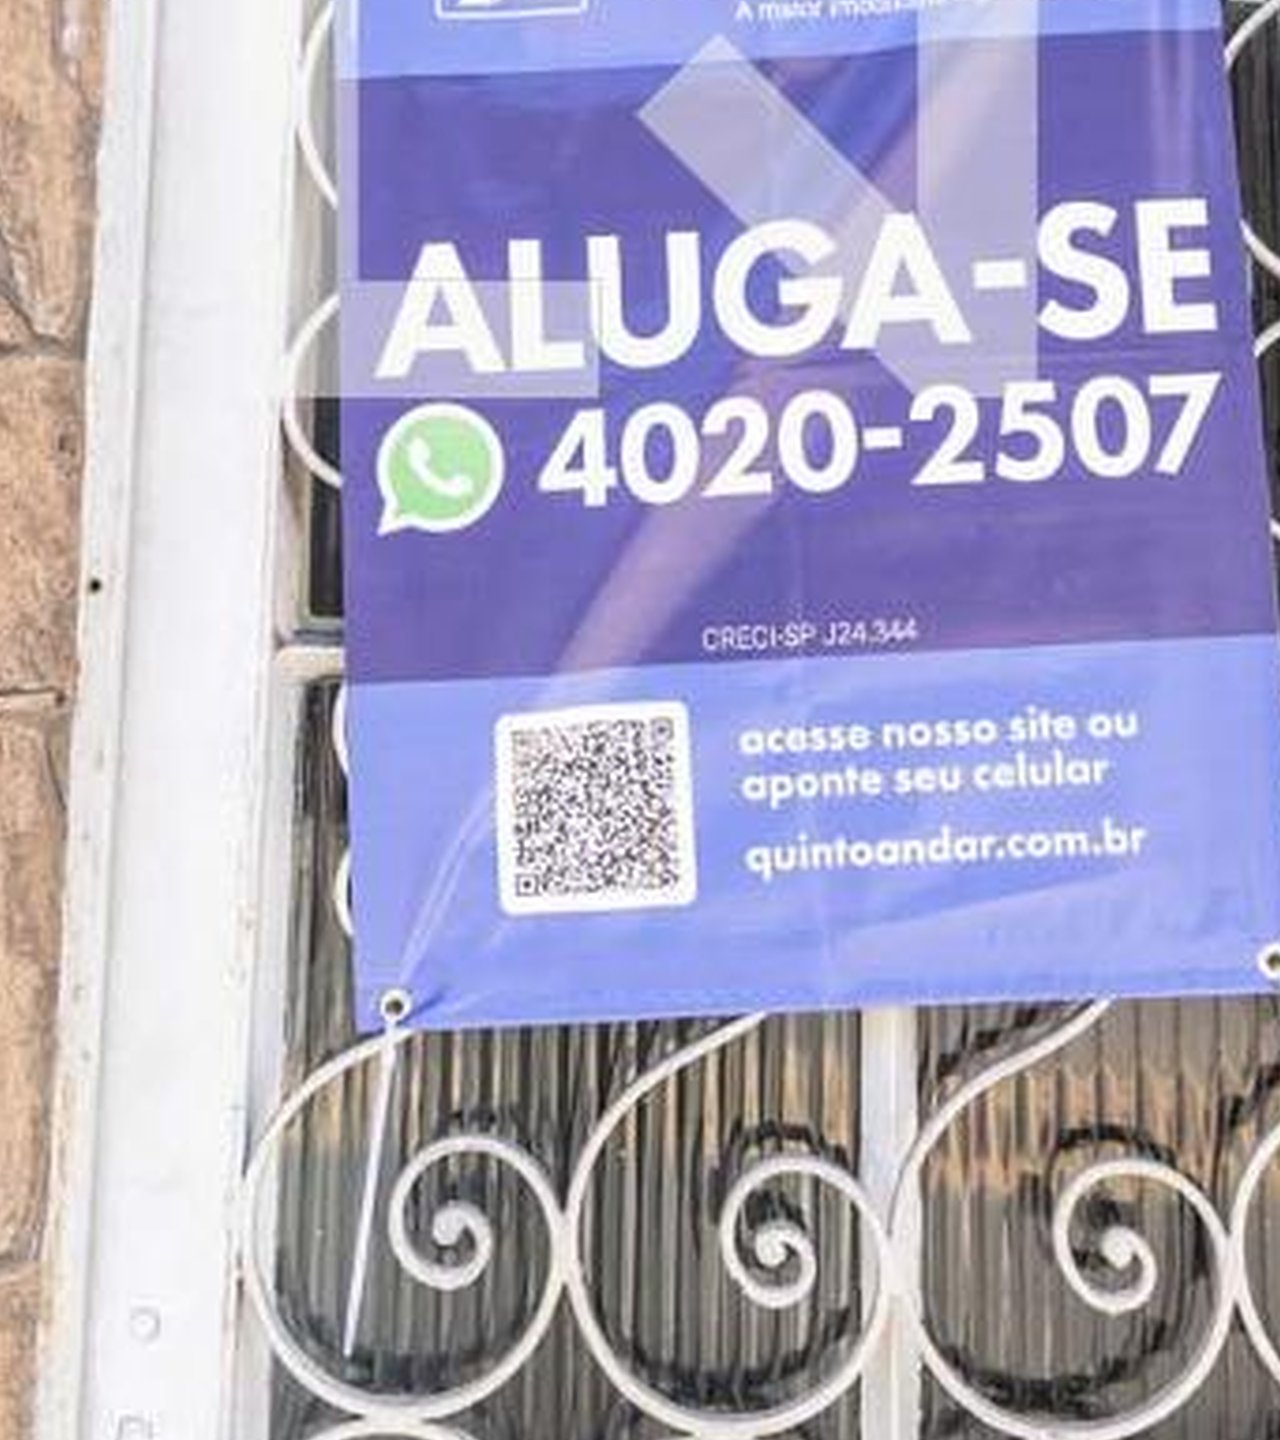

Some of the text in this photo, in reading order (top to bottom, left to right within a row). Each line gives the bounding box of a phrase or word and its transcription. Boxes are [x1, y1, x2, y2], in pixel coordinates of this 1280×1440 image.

[735, 0, 754, 21] A
[375, 199, 1219, 379] ALUGA-SE
[537, 372, 1222, 508] 4020-2507
[701, 621, 816, 651] CRECI-SP
[739, 705, 1139, 756] acesse nosso site ou
[741, 749, 1110, 810] aponte seu celular
[744, 816, 1147, 882] quintoandar.com.br
